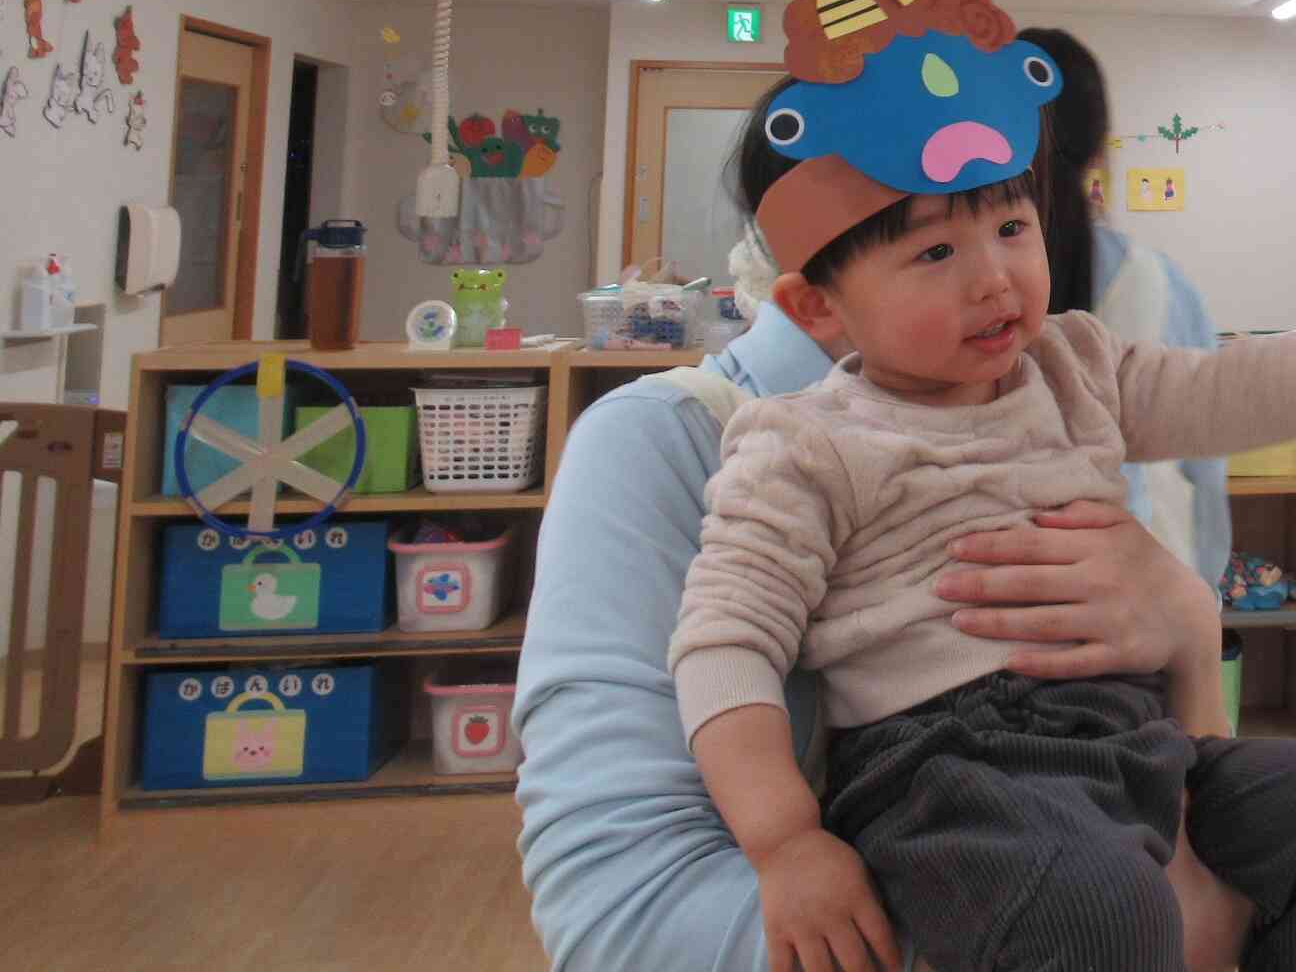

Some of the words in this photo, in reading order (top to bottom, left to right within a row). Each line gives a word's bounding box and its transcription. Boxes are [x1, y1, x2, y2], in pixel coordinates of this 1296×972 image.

[182, 678, 331, 697] かばんいれ
